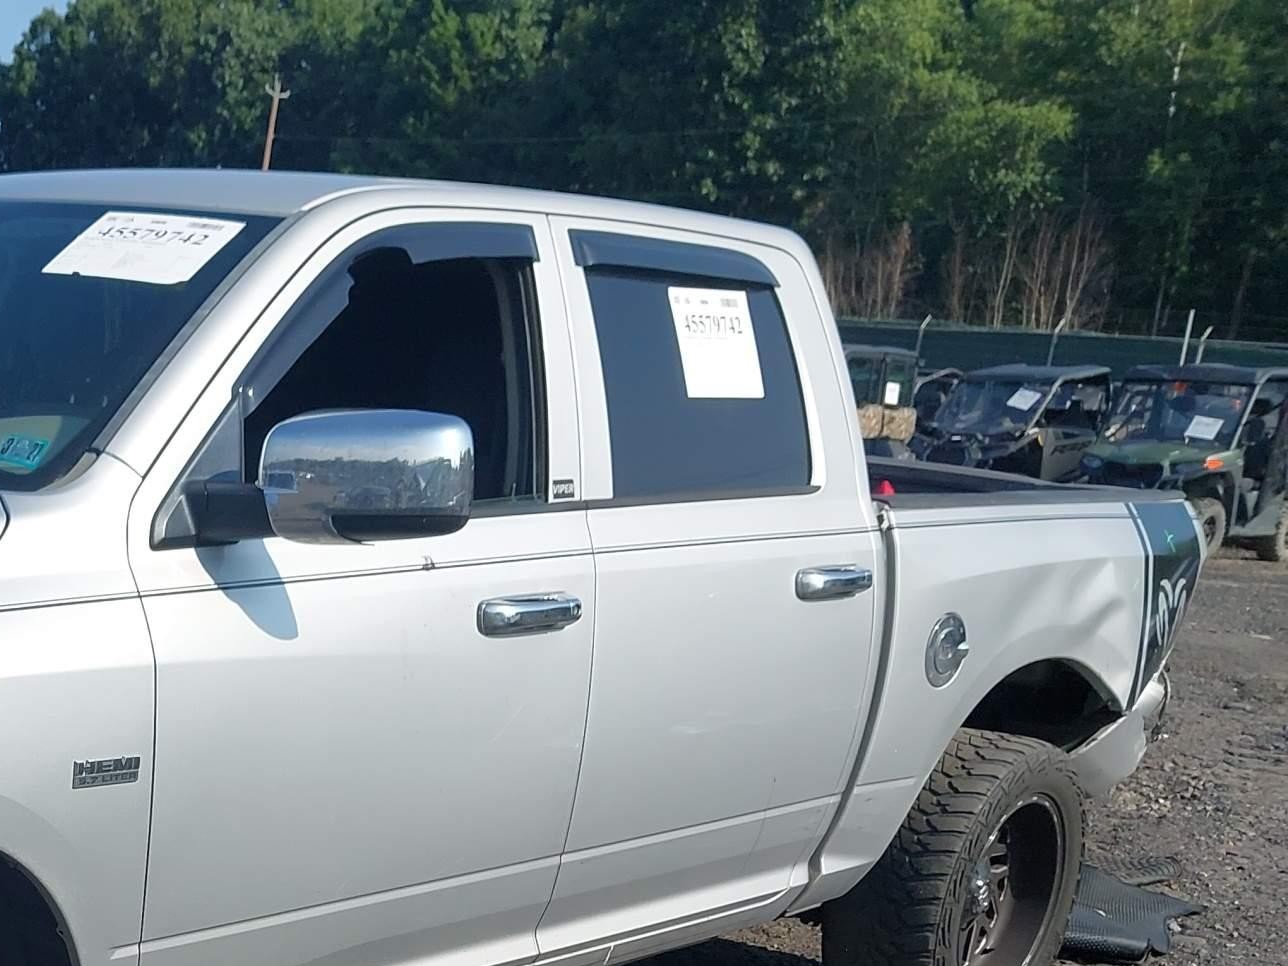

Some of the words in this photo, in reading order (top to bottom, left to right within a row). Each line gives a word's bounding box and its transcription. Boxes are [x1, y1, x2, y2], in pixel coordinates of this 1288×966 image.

[98, 226, 210, 246] 45579742
[685, 314, 743, 336] 45579742
[552, 482, 574, 495] VIPER
[73, 756, 141, 776] HEMI
[101, 771, 138, 783] LITER
